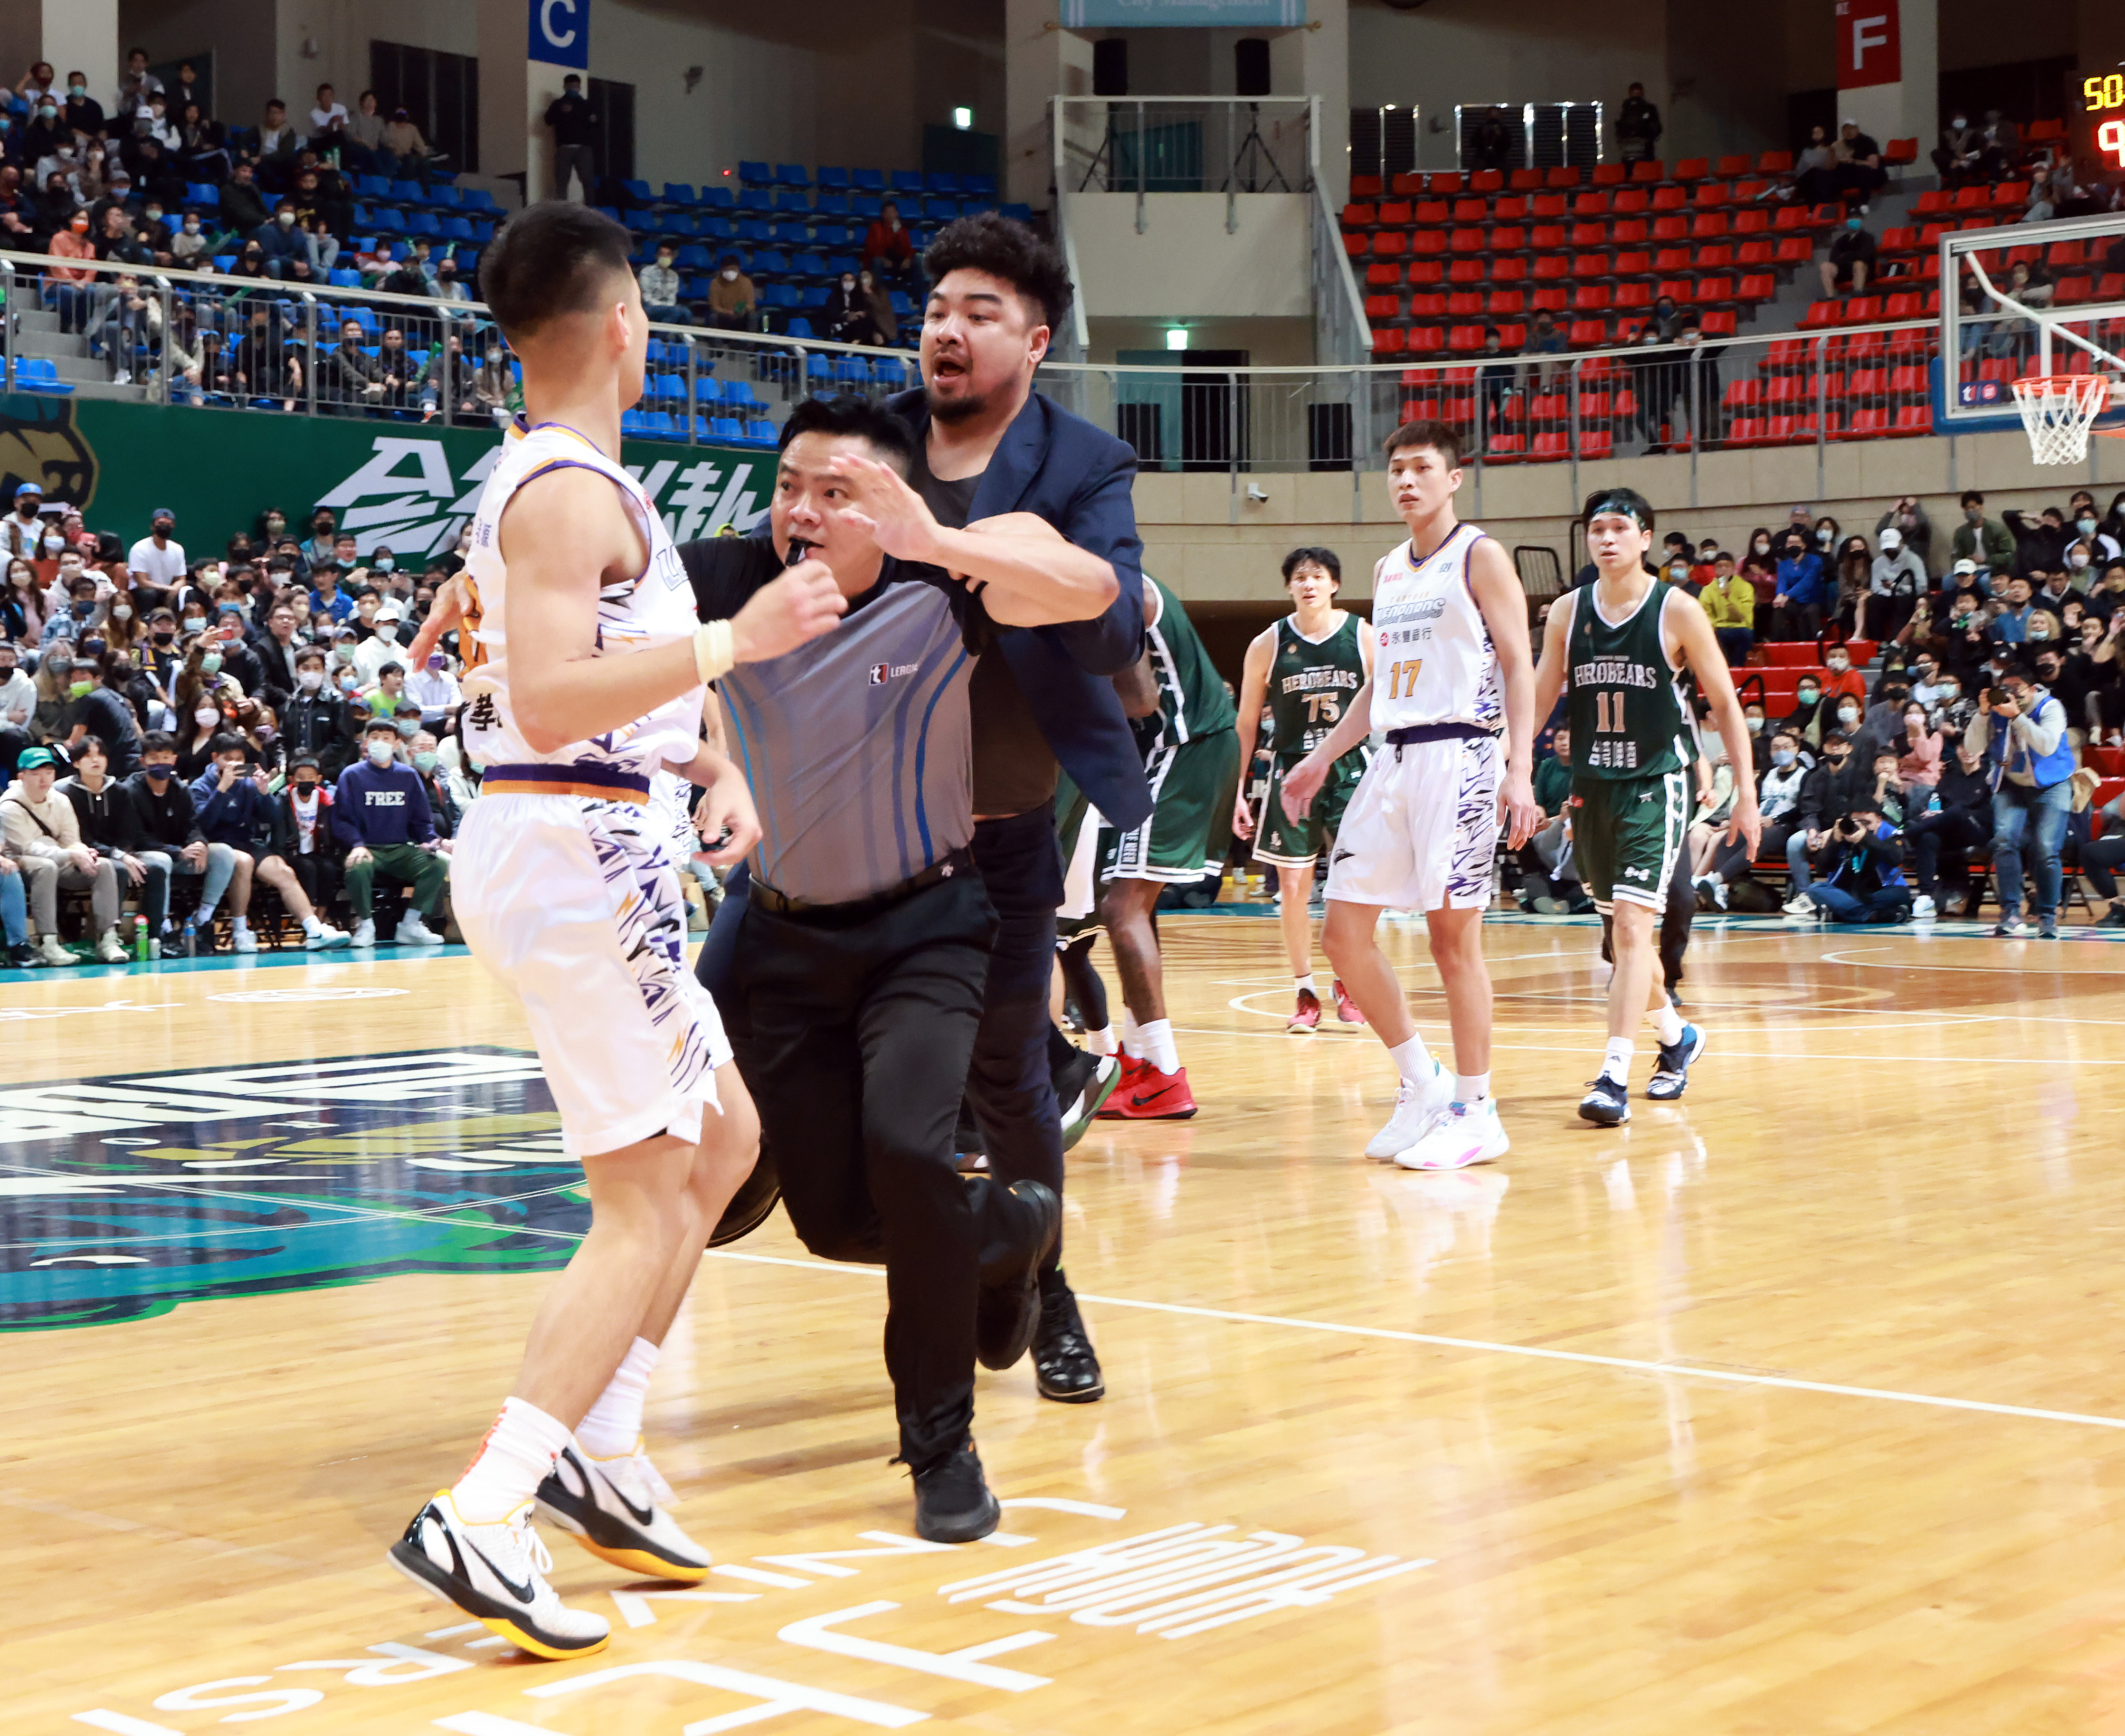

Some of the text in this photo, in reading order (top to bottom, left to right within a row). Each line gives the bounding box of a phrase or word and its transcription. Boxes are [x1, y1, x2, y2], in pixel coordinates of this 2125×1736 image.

[541, 0, 576, 48] C
[1853, 15, 1887, 70] F
[1389, 659, 1423, 700] 17
[1301, 692, 1341, 723] 75
[1596, 692, 1626, 733] 11
[364, 791, 406, 806] FREE
